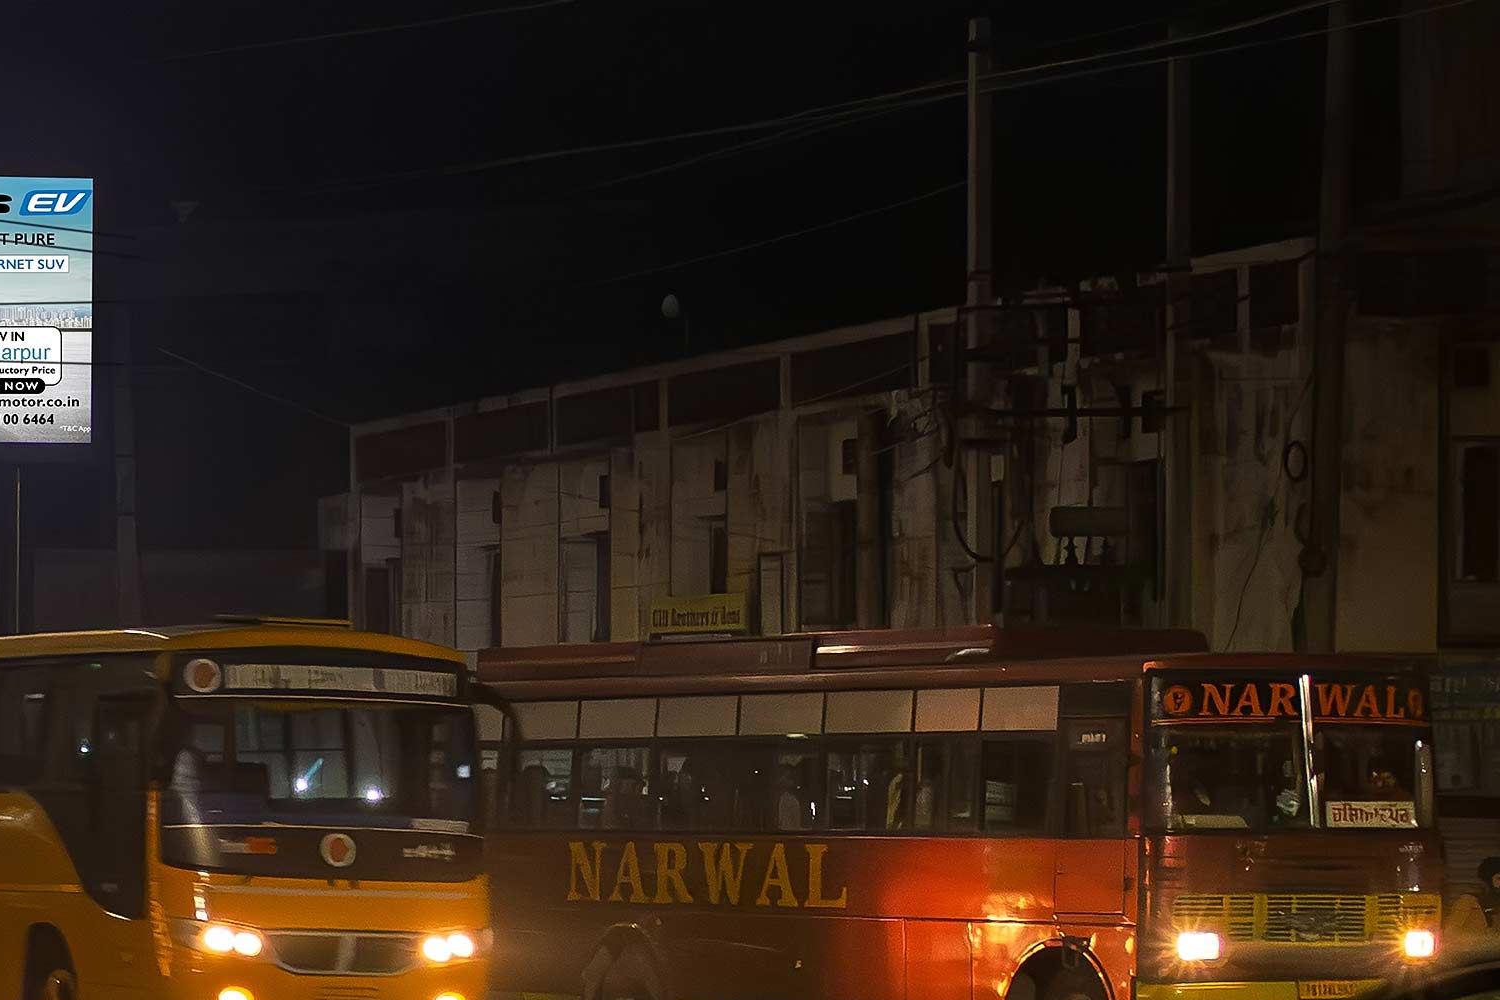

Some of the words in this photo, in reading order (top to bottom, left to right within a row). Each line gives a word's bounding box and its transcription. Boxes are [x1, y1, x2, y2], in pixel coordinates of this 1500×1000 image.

[27, 192, 86, 212] EV
[14, 233, 55, 246] PURE
[37, 259, 65, 270] SUV
[11, 331, 25, 342] IN
[32, 366, 56, 375] Price
[4, 381, 39, 391] NOW
[22, 413, 54, 425] 6464
[566, 840, 848, 909] NARWAL
